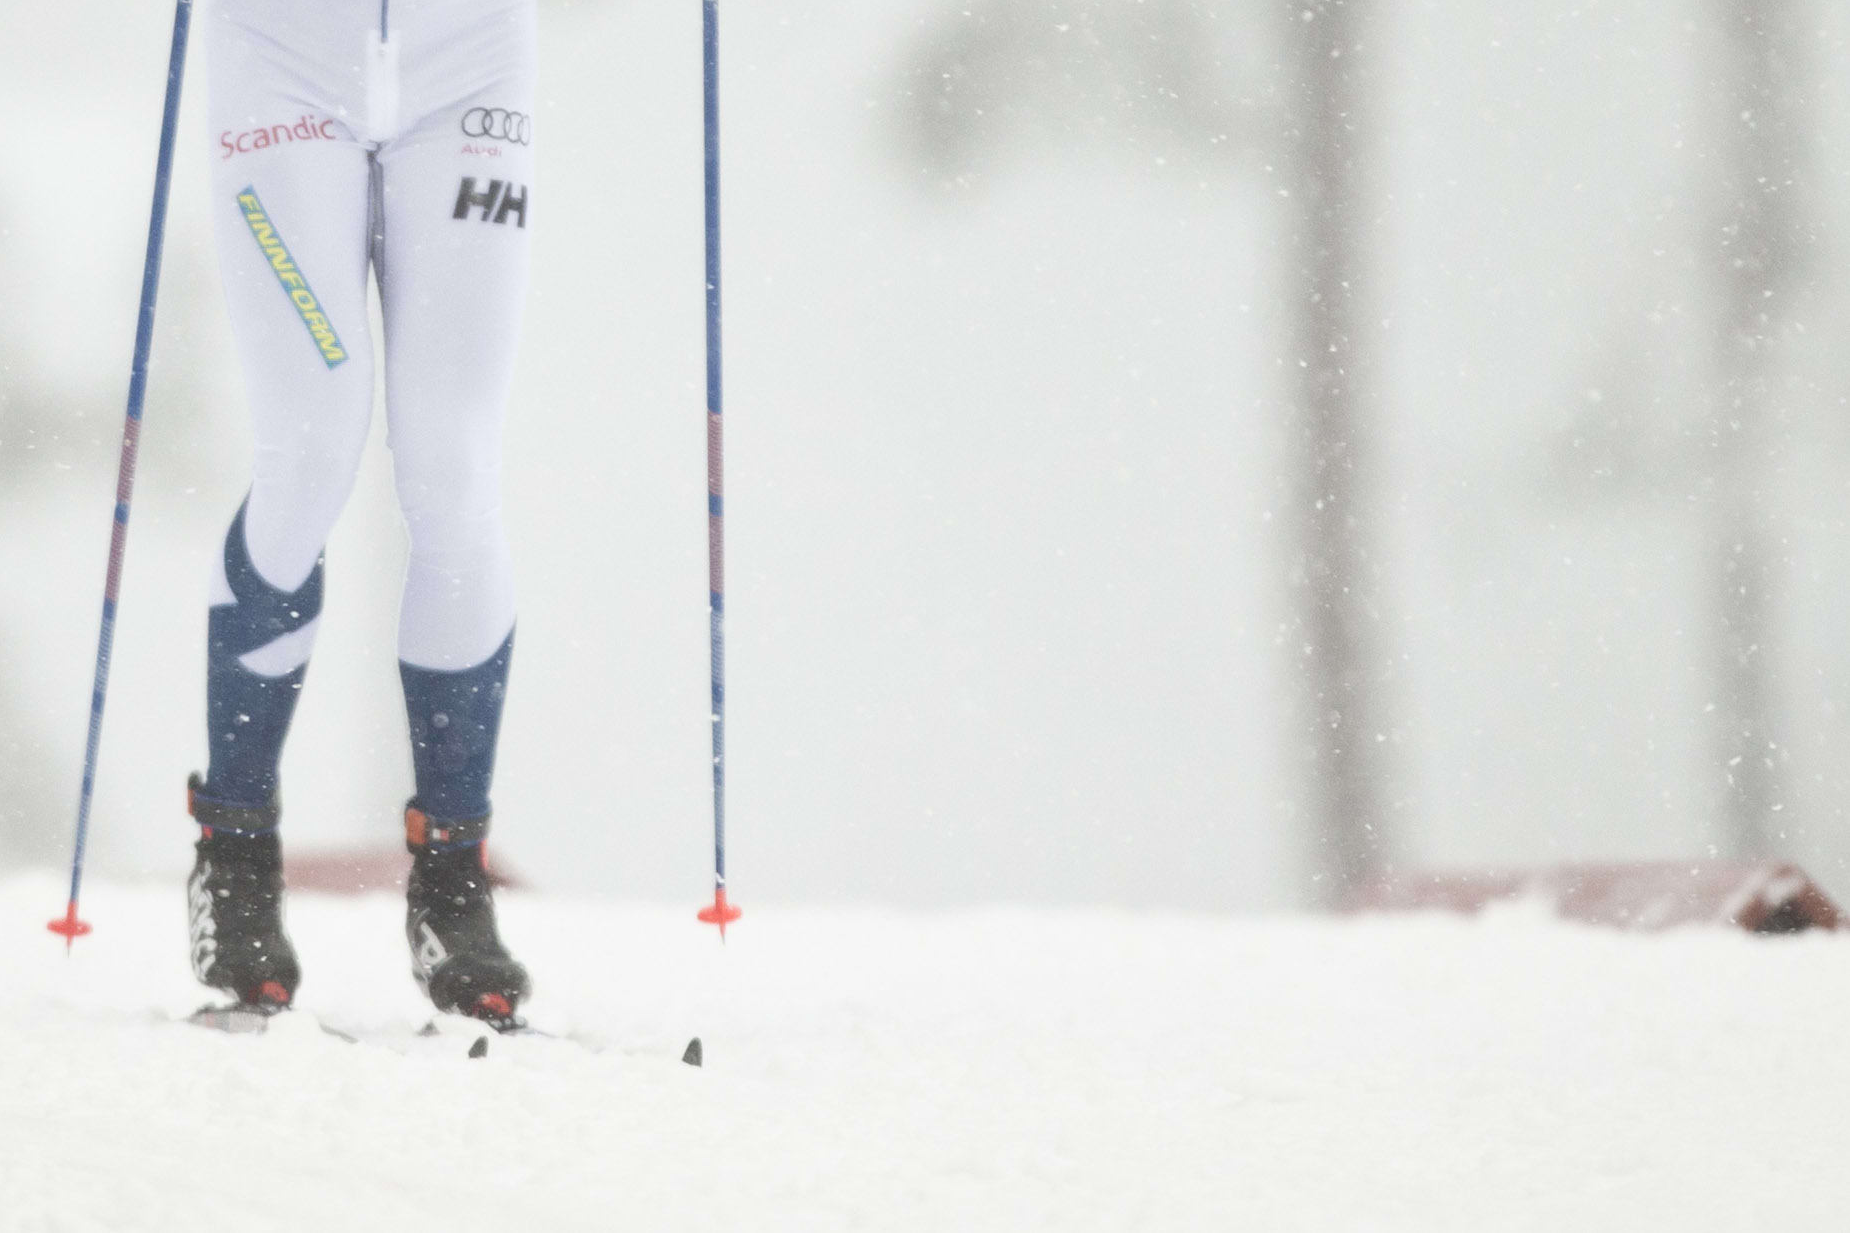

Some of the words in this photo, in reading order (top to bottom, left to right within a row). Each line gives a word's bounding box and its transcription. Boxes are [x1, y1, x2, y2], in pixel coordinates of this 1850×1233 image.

[220, 114, 337, 160] Scandic
[452, 176, 528, 229] HH
[238, 193, 345, 363] FINNFORM
